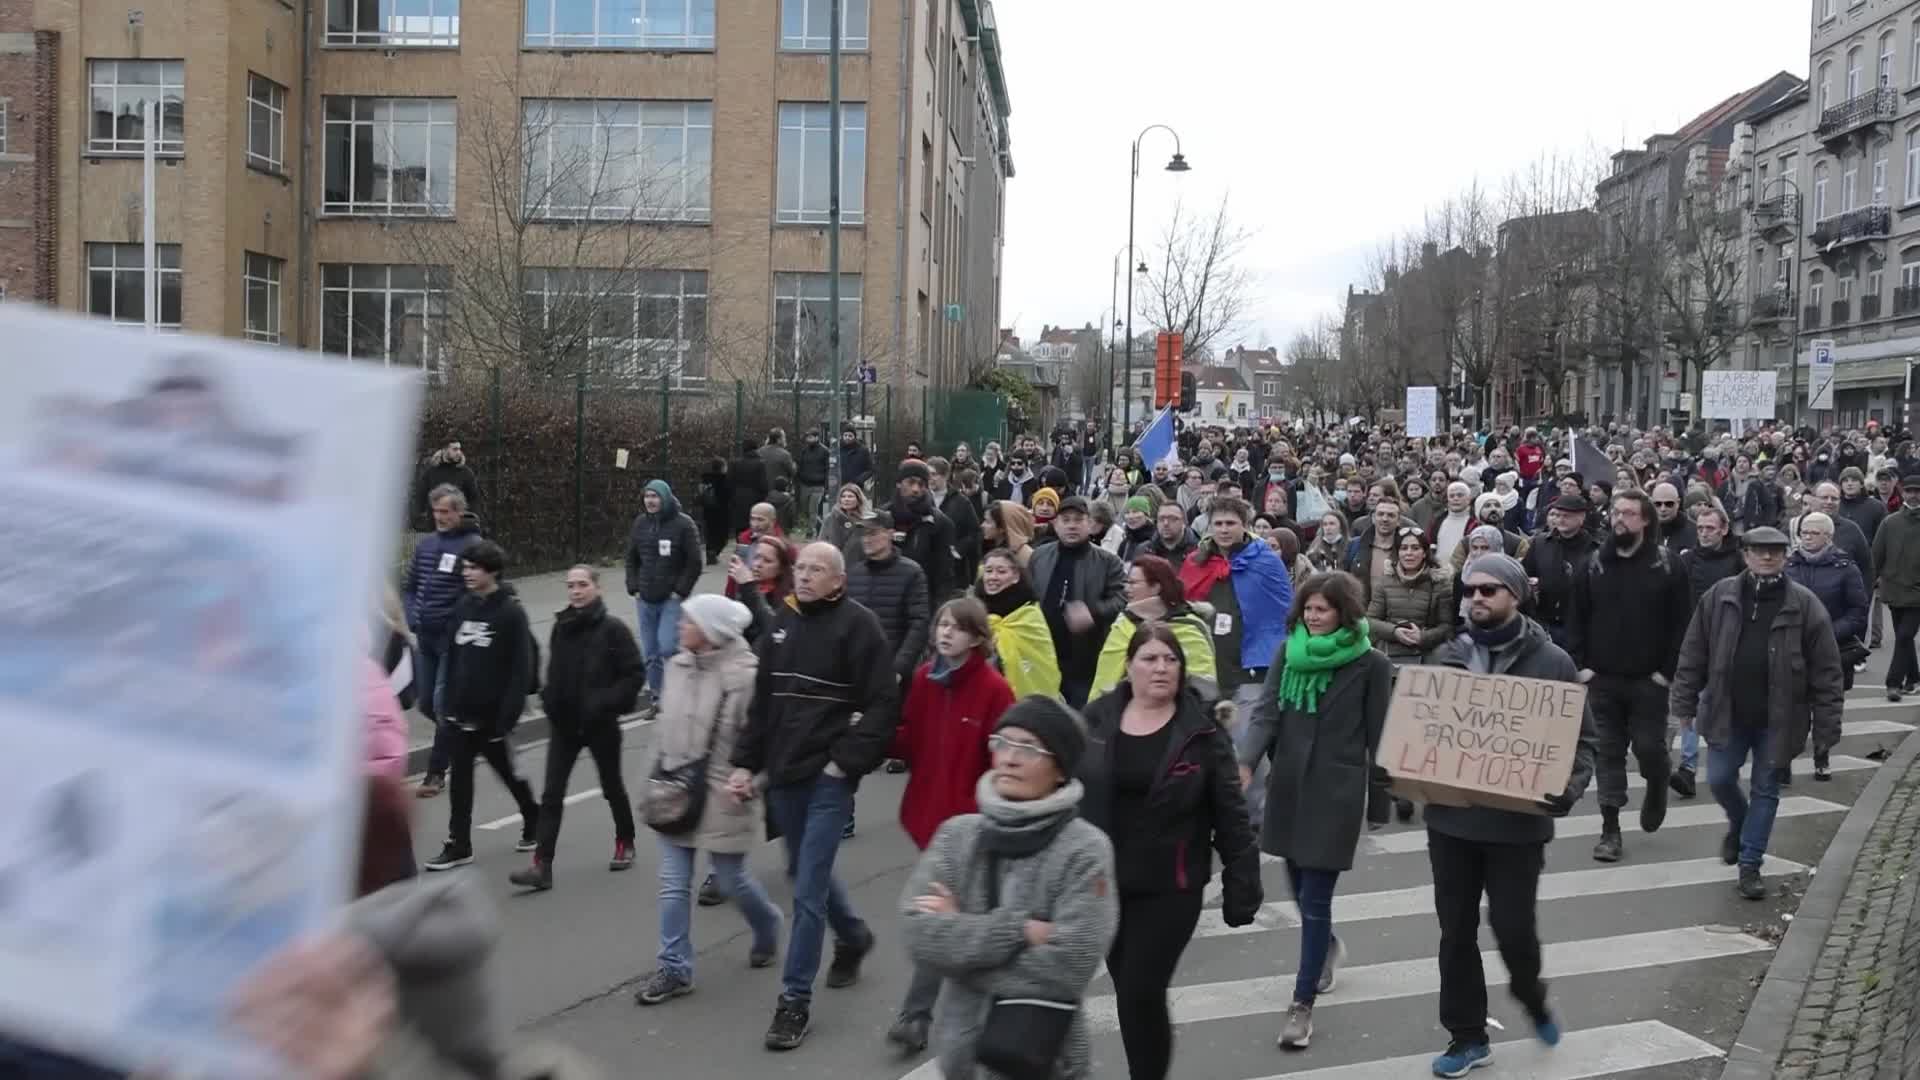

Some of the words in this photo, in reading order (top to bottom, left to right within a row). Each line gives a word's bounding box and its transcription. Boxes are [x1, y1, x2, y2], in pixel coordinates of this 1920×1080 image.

[1402, 670, 1580, 718] INTERDIRE
[1413, 702, 1440, 719] DE
[1453, 706, 1526, 733] VIVRE
[1424, 722, 1561, 762] PROVOQUE
[1399, 743, 1438, 777] LA
[1457, 751, 1548, 790] MORT
